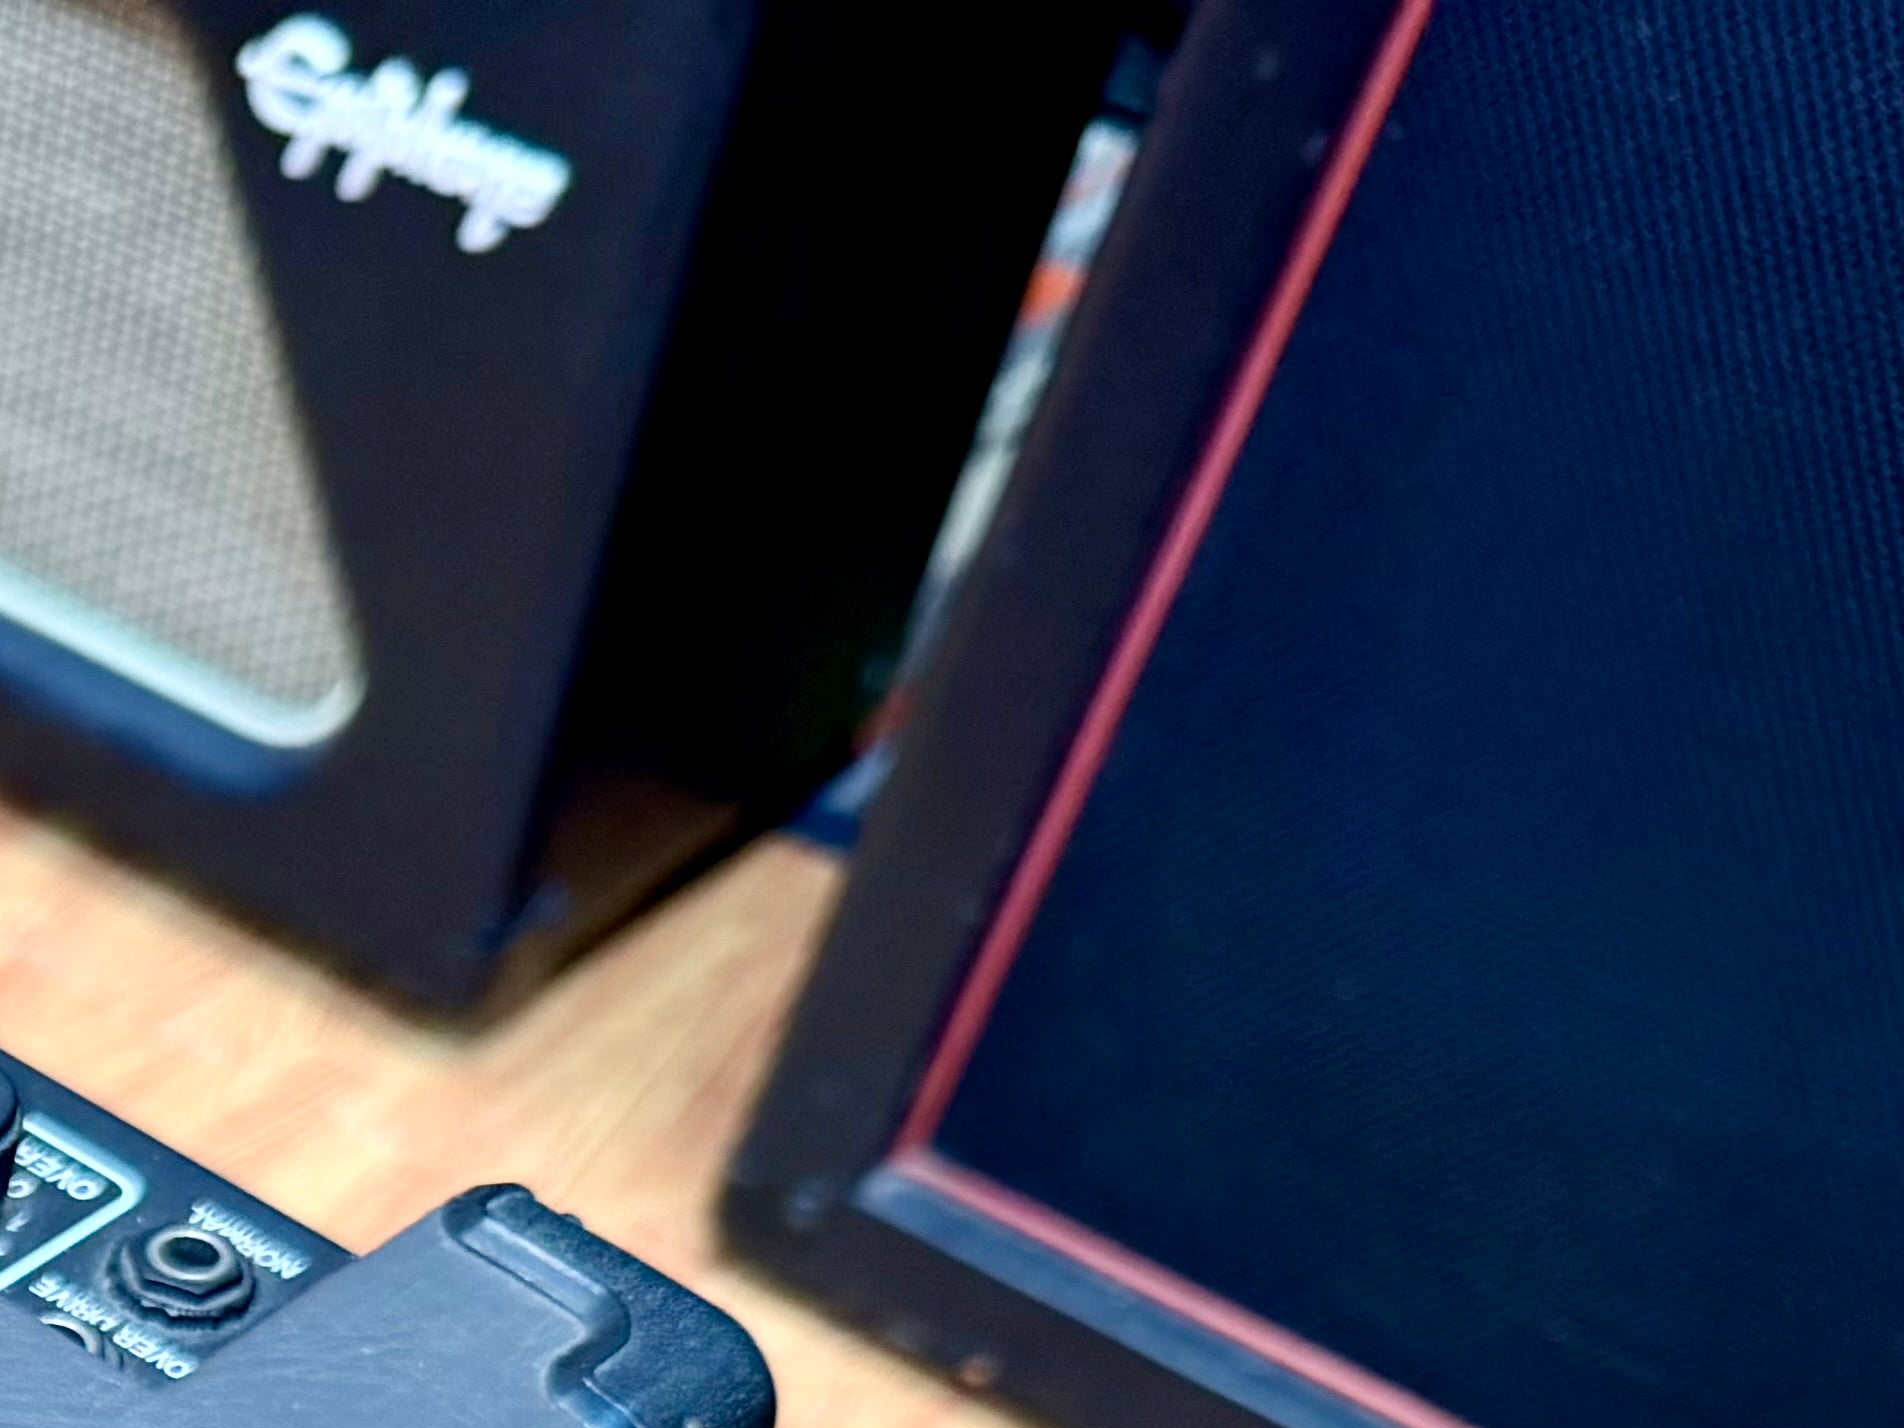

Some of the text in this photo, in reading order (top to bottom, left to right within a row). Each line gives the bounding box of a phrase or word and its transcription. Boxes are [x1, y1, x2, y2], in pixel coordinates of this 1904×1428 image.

[188, 1200, 312, 1280] NORMAL
[28, 1272, 198, 1380] OVER DRIVE
